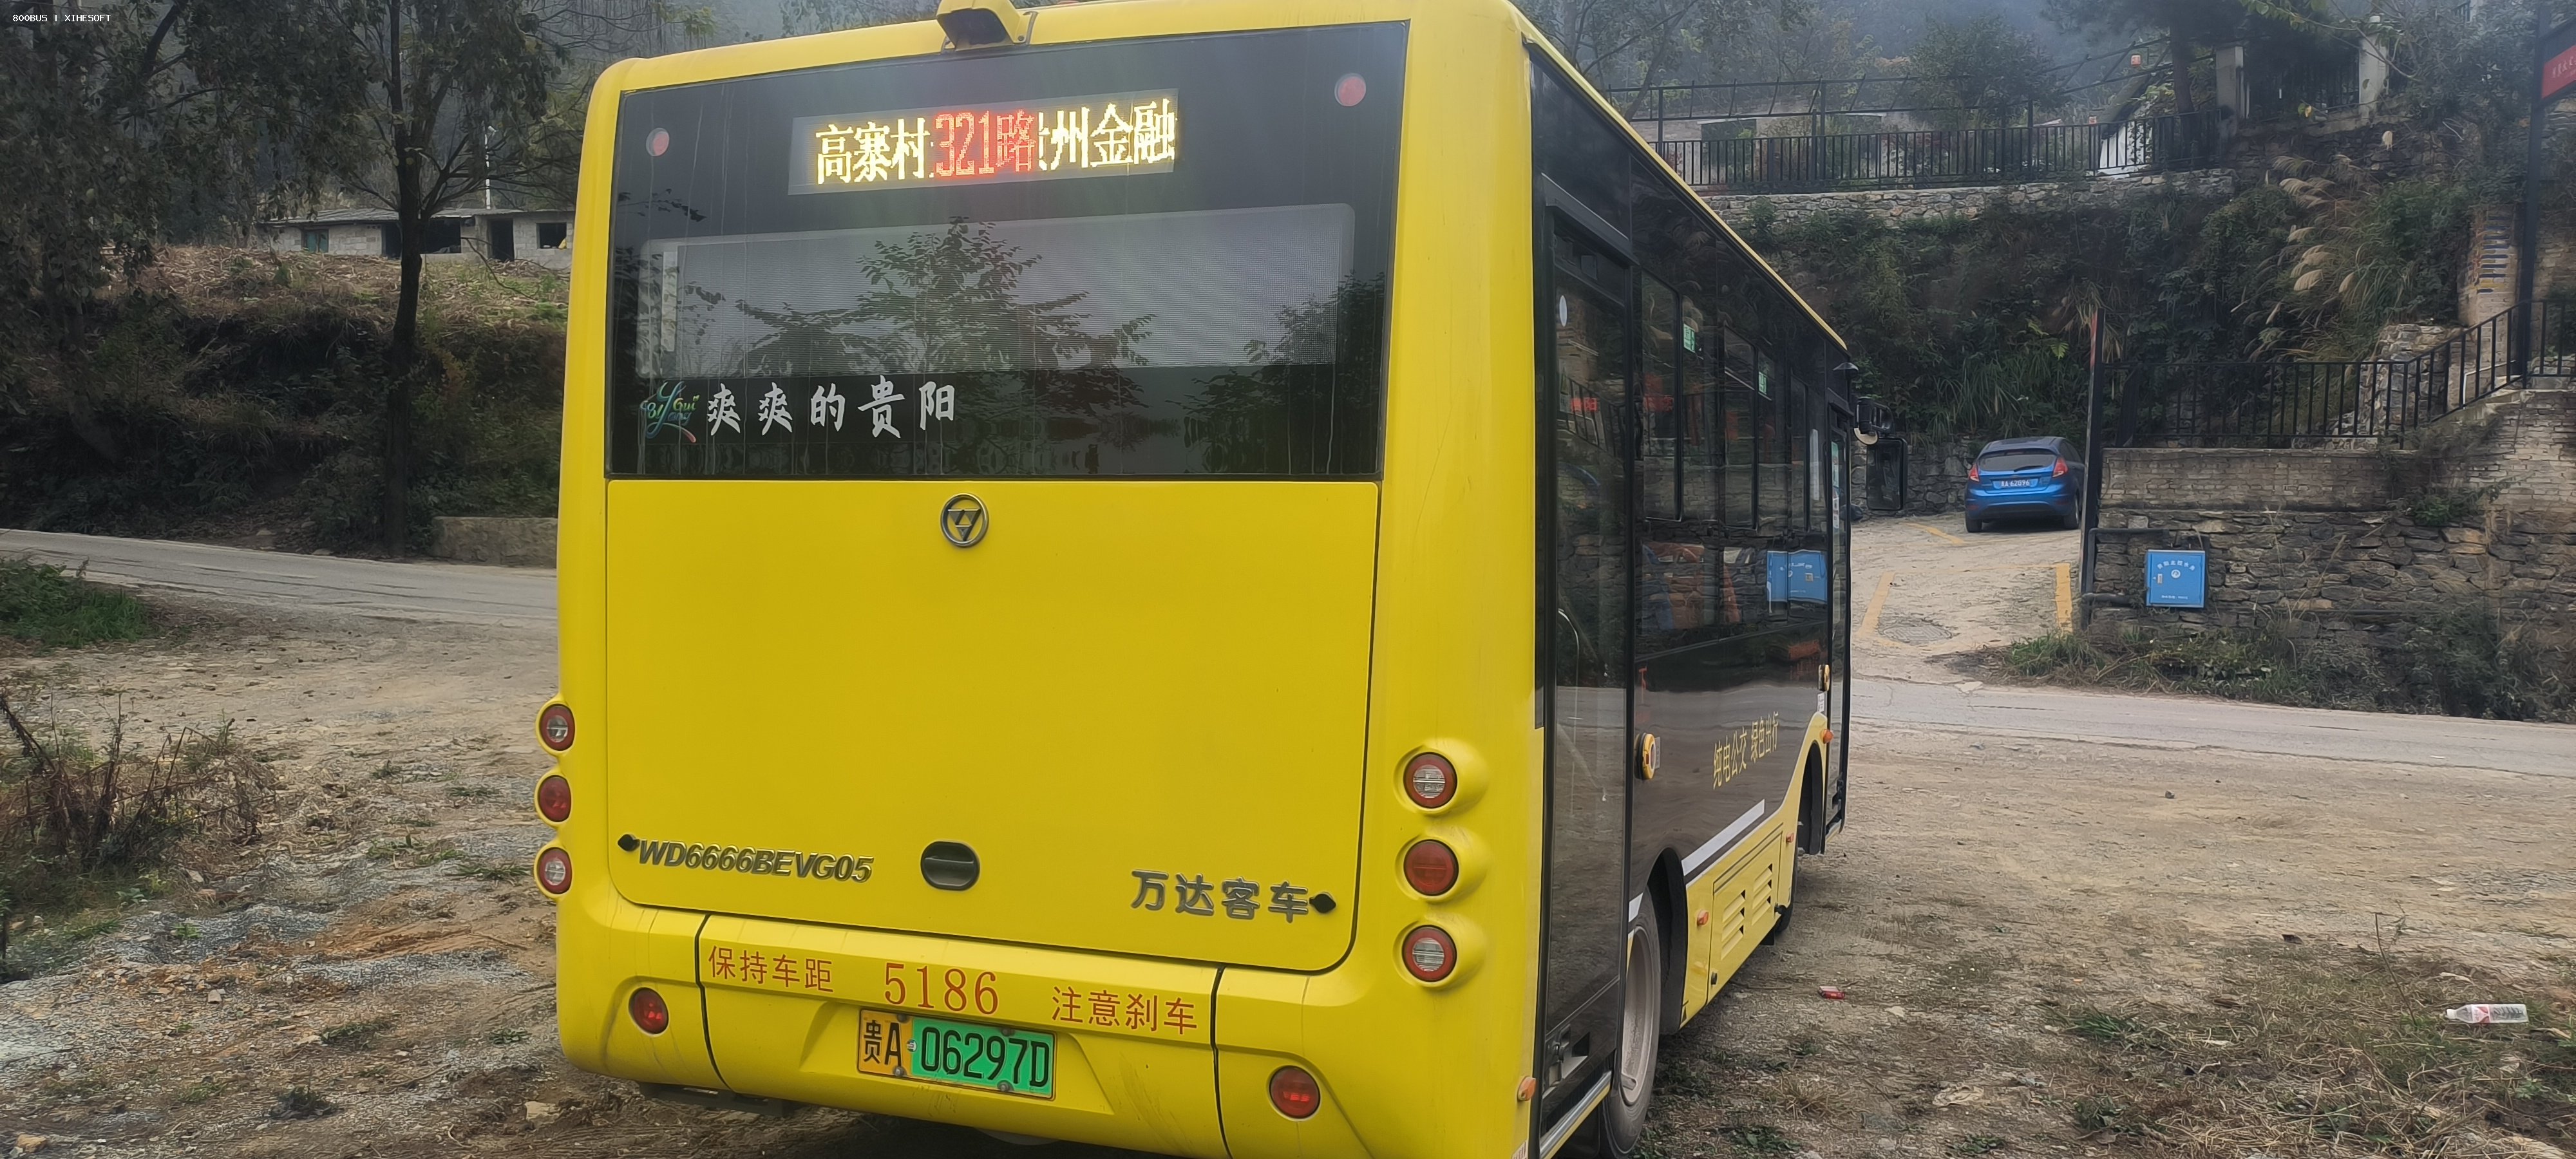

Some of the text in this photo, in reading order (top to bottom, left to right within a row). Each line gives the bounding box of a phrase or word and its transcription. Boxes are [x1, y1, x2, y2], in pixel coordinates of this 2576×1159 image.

[707, 375, 955, 439] 爽爽的贵阳
[1713, 711, 1779, 789] 纯电公交 绿色出行
[638, 838, 875, 883] WD6666BEVG05
[1130, 869, 1309, 923] 万达客车
[708, 945, 834, 992] 保持车距
[884, 961, 999, 1015] 5186
[1052, 986, 1197, 1035] 注意刹车
